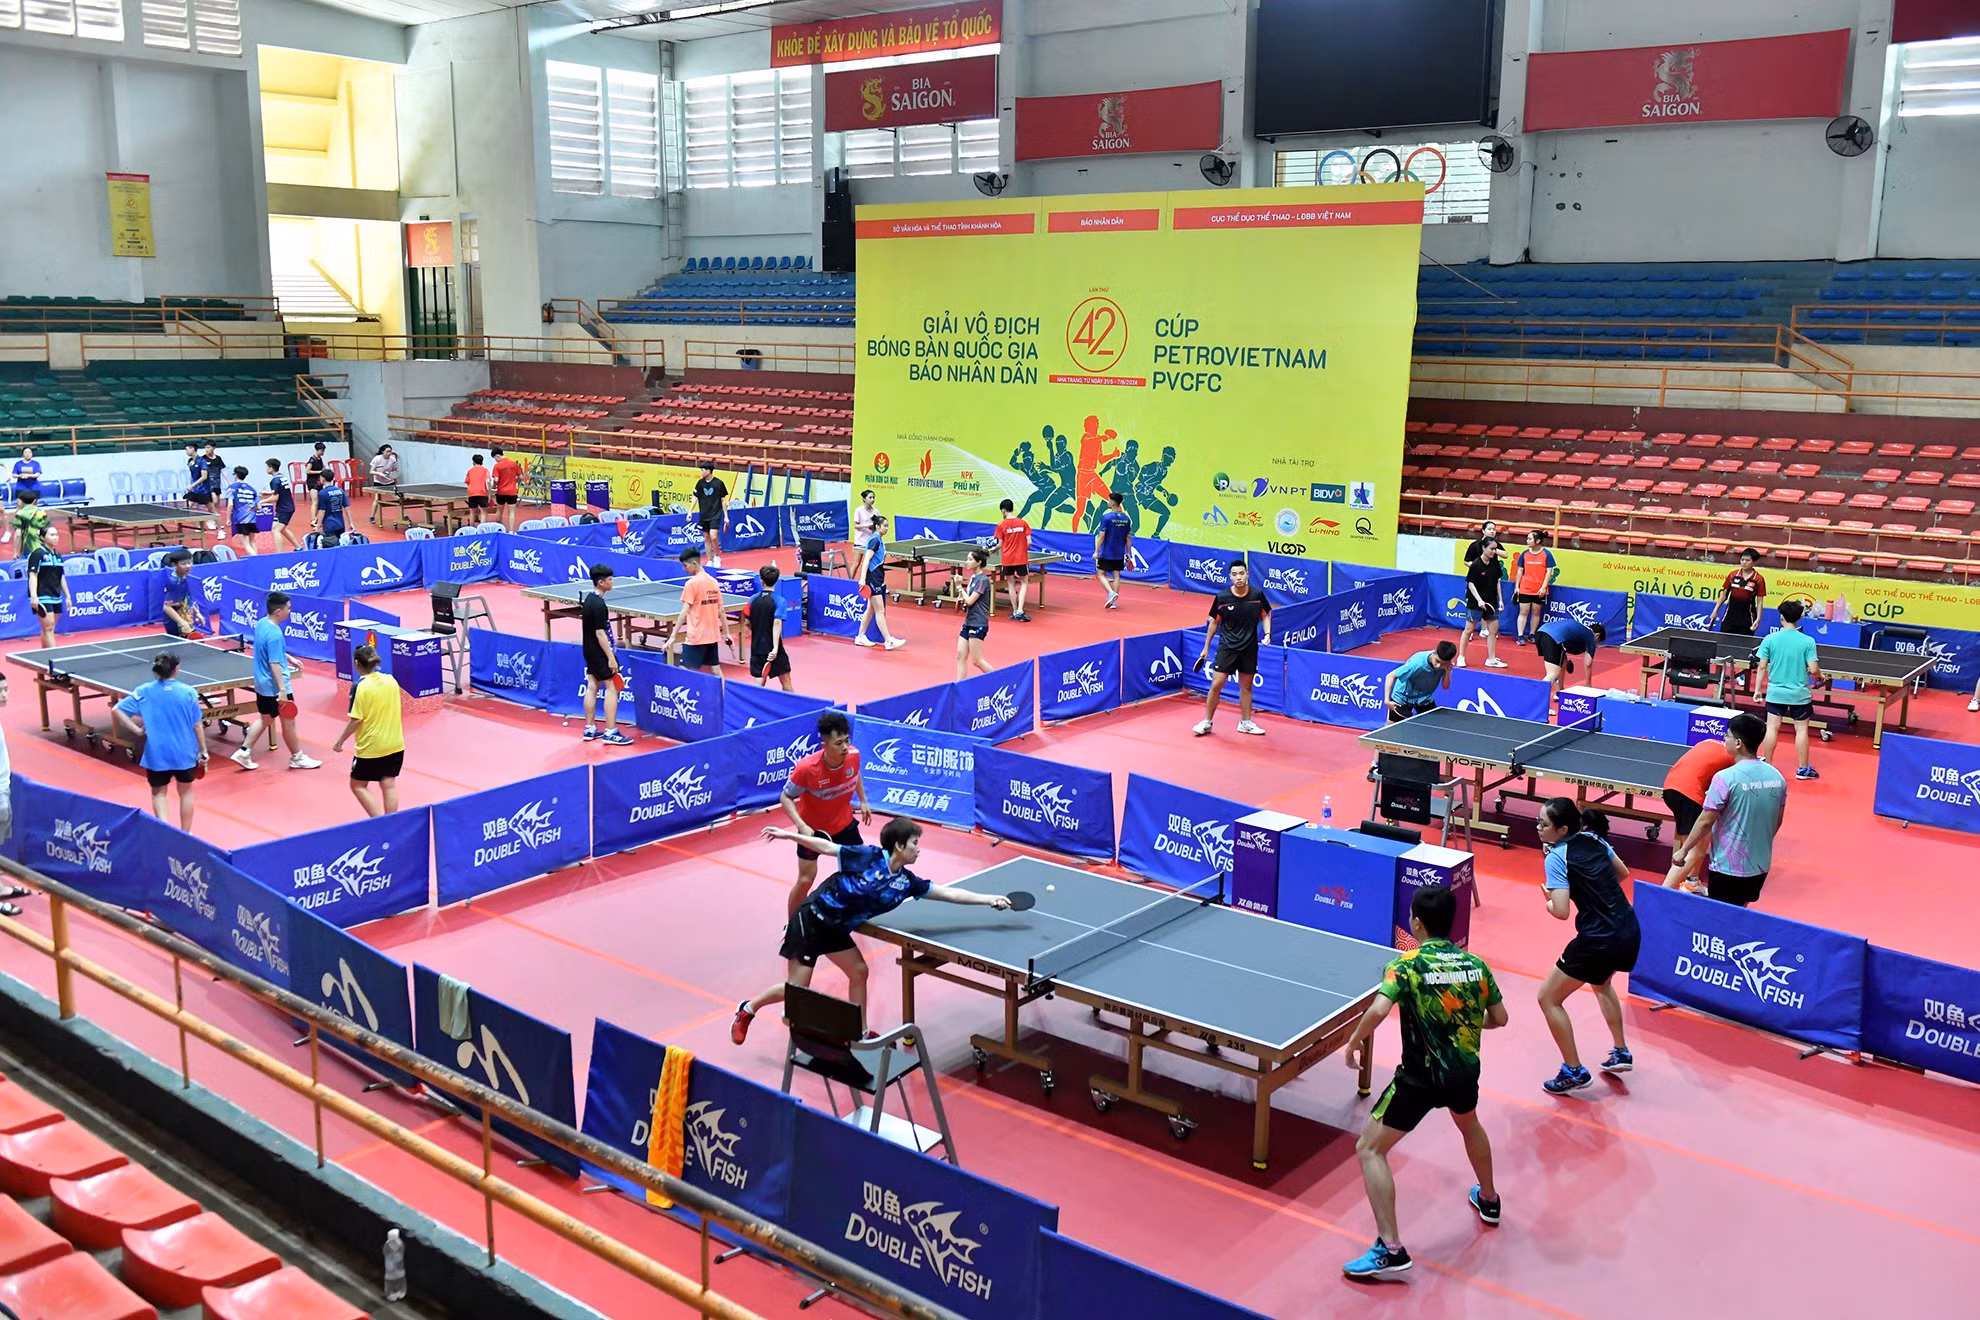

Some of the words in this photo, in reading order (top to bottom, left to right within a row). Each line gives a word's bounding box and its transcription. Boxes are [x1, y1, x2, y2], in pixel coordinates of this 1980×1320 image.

[777, 31, 803, 57] KHỎE
[807, 26, 820, 54] ĐỂ
[824, 29, 845, 53] XÂY
[848, 28, 877, 54] DỰNG
[881, 25, 895, 47] VÀ
[898, 18, 920, 44] BẢO
[925, 17, 938, 45] VỆ
[942, 10, 957, 39] TỔ
[961, 8, 991, 40] QUỐC
[911, 78, 930, 90] BIA
[891, 89, 952, 111] SAIGON
[1663, 94, 1680, 103] BIA
[1642, 103, 1700, 117] SAIGON
[1105, 131, 1117, 139] BIA
[1092, 138, 1129, 149] SAIGON
[1080, 217, 1092, 227] BÁO
[1093, 217, 1109, 227] NHÂN
[1110, 217, 1124, 226] DÂN
[1211, 215, 1225, 223] CỤC
[1226, 211, 1240, 221] THỂ
[1241, 214, 1255, 223] DỤC
[1256, 211, 1271, 221] THỂ
[1317, 211, 1334, 220] VIỆT
[923, 222, 931, 231] VÀ
[942, 222, 957, 231] THAO
[923, 310, 958, 334] GIẢI
[965, 311, 988, 334] VÔ
[994, 317, 1039, 339] ĐỊCH
[1072, 306, 1116, 356] 42
[1155, 312, 1199, 338] CÚP
[867, 334, 911, 357] BÓNG
[915, 335, 949, 358] BÀN
[953, 332, 1003, 359] QUỐC
[1008, 341, 1039, 360] GIA
[1153, 345, 1327, 369] PETROVIETNAM
[909, 359, 943, 381] BÁO
[947, 359, 995, 383] NHÂN
[1001, 360, 1038, 385] DÂN
[1152, 371, 1222, 393] PVCFC
[1272, 457, 1287, 466] NHÀ
[960, 471, 974, 480] NPK
[658, 478, 673, 490] CÚP
[907, 478, 944, 489] PETROVIETNAM
[1270, 485, 1307, 496] VNPT
[1313, 488, 1334, 499] BIDV
[735, 531, 765, 539] MOFIT
[797, 524, 816, 532] DOUBLE
[1309, 528, 1341, 536] LI-NING
[668, 536, 688, 546] DOUBLE
[1267, 541, 1307, 556] VLOOP
[450, 561, 474, 572] DOUBLE
[480, 557, 493, 567] FISH
[509, 560, 529, 571] DOUBLE
[1602, 562, 1612, 570] SỞ
[1613, 563, 1627, 571] VĂN
[1627, 564, 1641, 572] HÓA
[1642, 565, 1651, 573] VÀ
[1653, 566, 1666, 575] THỂ
[1667, 569, 1686, 577] THAO
[1686, 569, 1703, 579] TỈNH
[361, 577, 402, 586] MOFIT
[1185, 570, 1207, 581] DOUBLE
[1213, 574, 1227, 584] FISH
[1776, 578, 1791, 588] BÁO
[1791, 580, 1813, 590] NHÂN
[1814, 582, 1830, 591] DÂN
[270, 581, 299, 592] DOUBLE
[305, 579, 320, 588] FISH
[1263, 579, 1288, 592] DOUBLE
[1294, 584, 1309, 595] FISH
[1864, 588, 1882, 598] CỤC
[1883, 587, 1899, 598] THỂ
[1900, 591, 1917, 601] DỤC
[1918, 591, 1934, 601] THỂ
[1935, 594, 1958, 603] THAO
[69, 605, 103, 617] DOUBLE
[114, 602, 132, 612] FISH
[1378, 607, 1398, 618] DOUBLE
[1402, 604, 1414, 614] FISH
[1863, 600, 1905, 619] CÚP
[284, 626, 309, 639] DOUBLE
[315, 631, 329, 643] FISH
[1338, 623, 1354, 635] DOUBLE
[1357, 620, 1367, 631] FISH
[1937, 663, 1961, 674] FISH
[493, 672, 520, 688] DOUBLE
[524, 678, 538, 691] FISH
[1148, 671, 1182, 683] MOFIT
[1057, 687, 1083, 703] DOUBLE
[1090, 681, 1104, 694] FISH
[1311, 687, 1349, 705] DOUBLE
[1360, 697, 1382, 710] FISH
[650, 701, 678, 719] DOUBLE
[686, 712, 703, 725] FISH
[971, 713, 997, 732] DOUBLE
[911, 743, 975, 772] 运动服饰
[1445, 756, 1497, 770] MOFIT
[756, 766, 794, 786] DOUBLE
[881, 787, 952, 812] 双鱼体育
[1916, 783, 1974, 807] DOUBLE
[629, 800, 675, 824] DOUBLE
[687, 790, 712, 809] FISH
[1002, 799, 1043, 823] DOUBLE
[1055, 814, 1080, 832] FISH
[474, 839, 522, 868] DOUBLE
[535, 826, 562, 847] FISH
[1154, 833, 1203, 863] DOUBLE
[1216, 855, 1234, 873] FIS
[46, 841, 85, 865] DOUBLE
[93, 857, 112, 875] FISH
[164, 878, 194, 909] DOUBLE
[200, 901, 216, 921] FISH
[1314, 894, 1335, 906] DOUBLE
[957, 955, 1020, 983] MOFIT
[1674, 955, 1743, 992] DOUBLE
[1762, 985, 1804, 1010] FISH
[1227, 1040, 1246, 1052] 235
[711, 1157, 748, 1190] FISH
[845, 1212, 923, 1269] DOUBLE
[947, 1268, 993, 1302] FISH
